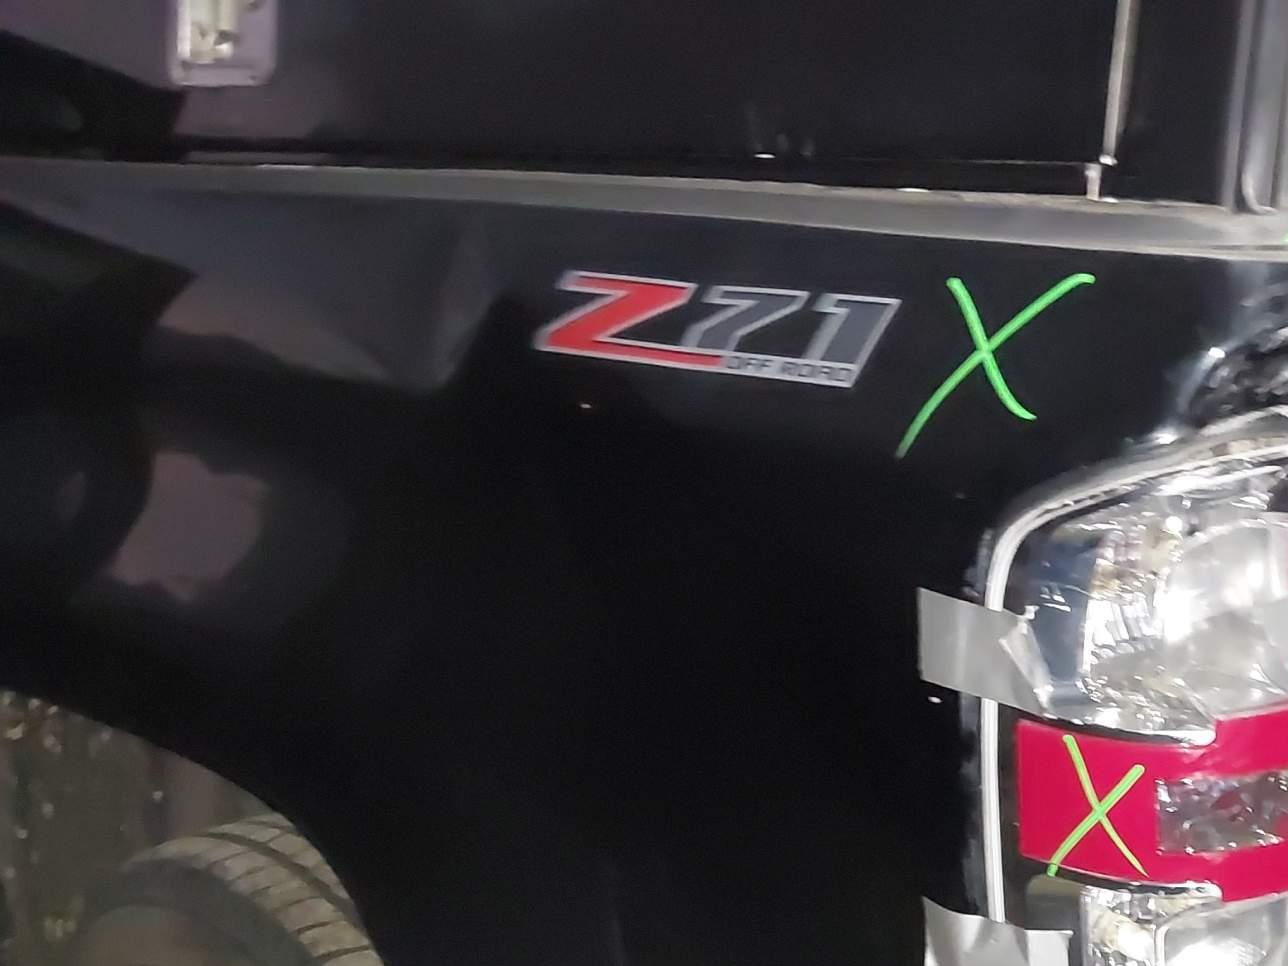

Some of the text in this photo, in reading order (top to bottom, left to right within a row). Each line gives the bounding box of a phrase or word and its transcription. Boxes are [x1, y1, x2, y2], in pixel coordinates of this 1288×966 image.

[531, 269, 902, 371] Z71
[725, 354, 853, 383] OFF ROAD
